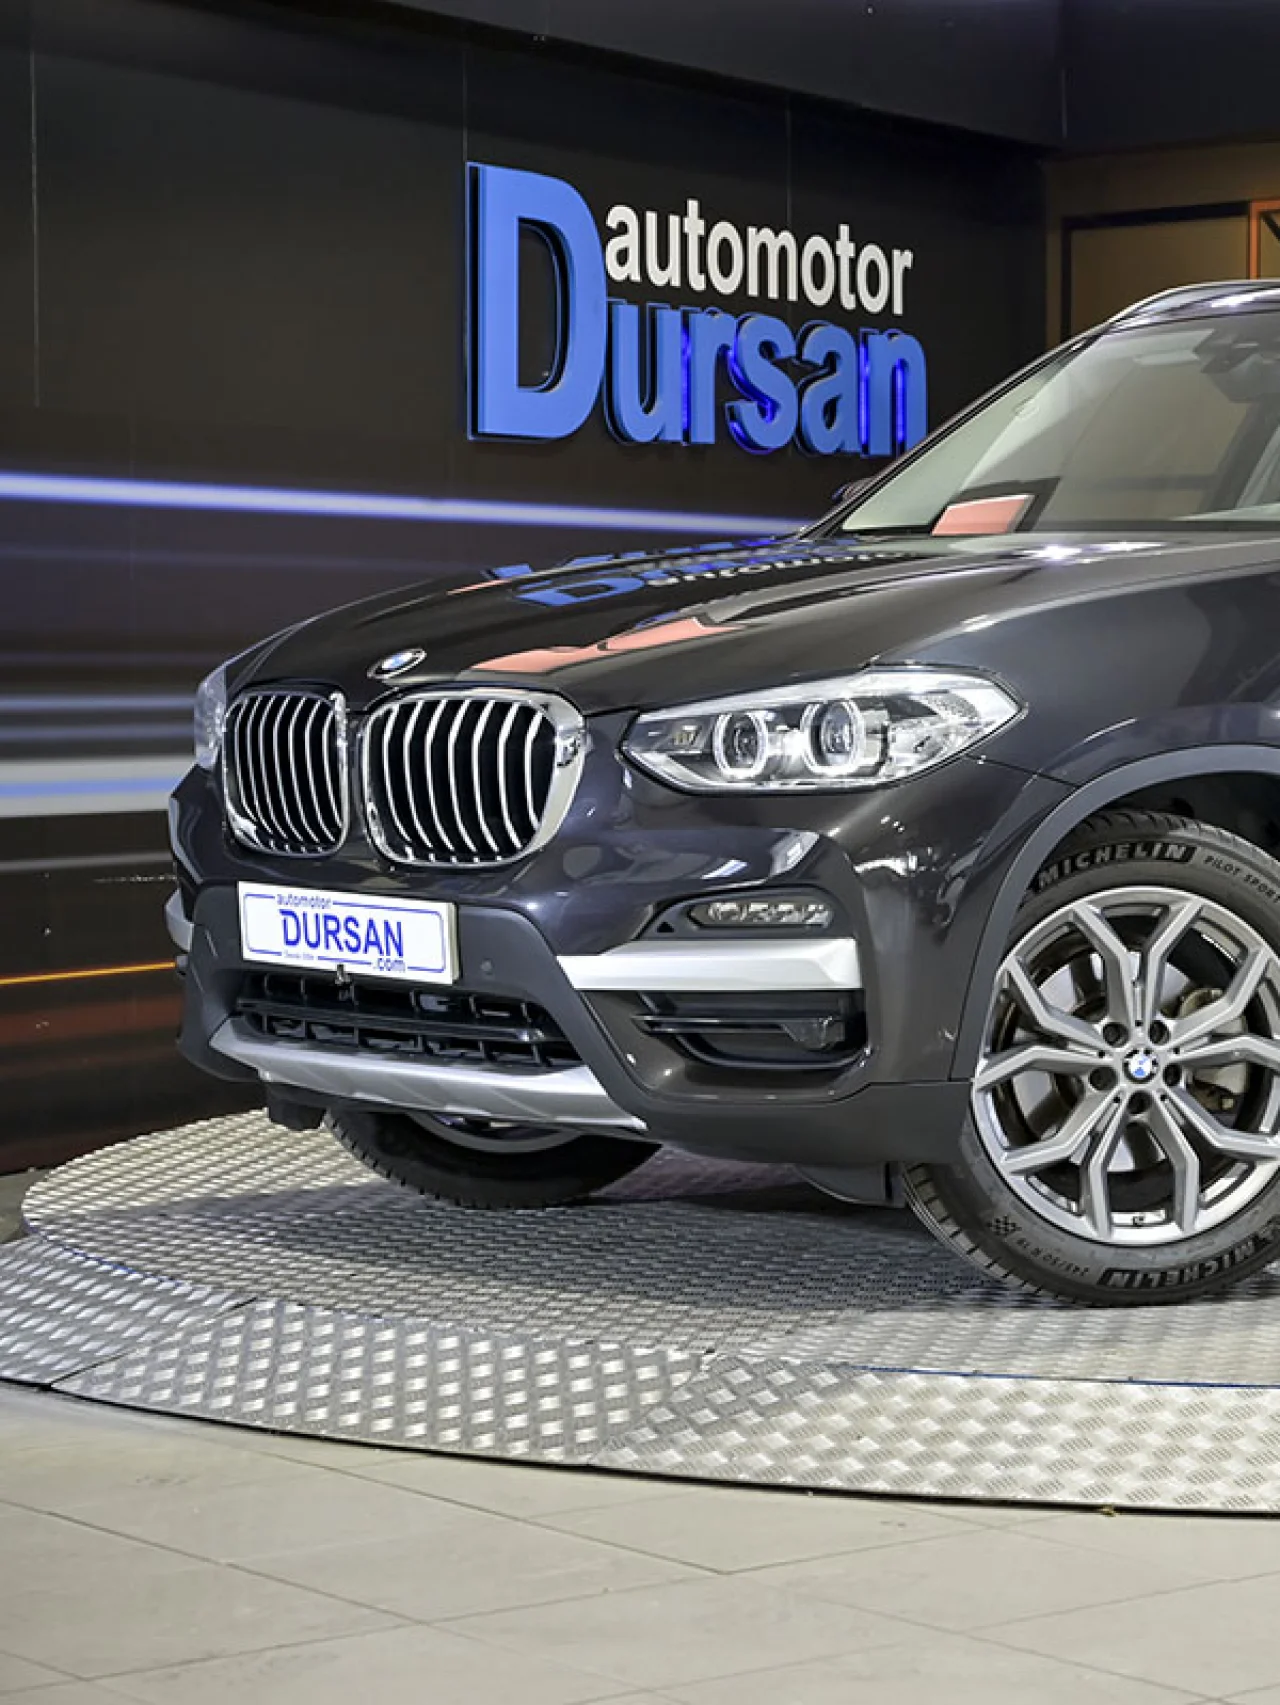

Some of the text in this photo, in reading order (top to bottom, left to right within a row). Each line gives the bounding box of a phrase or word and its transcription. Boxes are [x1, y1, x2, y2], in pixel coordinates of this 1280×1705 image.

[606, 199, 913, 315] automotor
[467, 161, 929, 458] Dursan
[1038, 841, 1188, 890] MICHELIN
[1204, 855, 1241, 875] PILOT
[279, 908, 404, 957] DURSAN
[1104, 1244, 1252, 1288] MICHELIN
